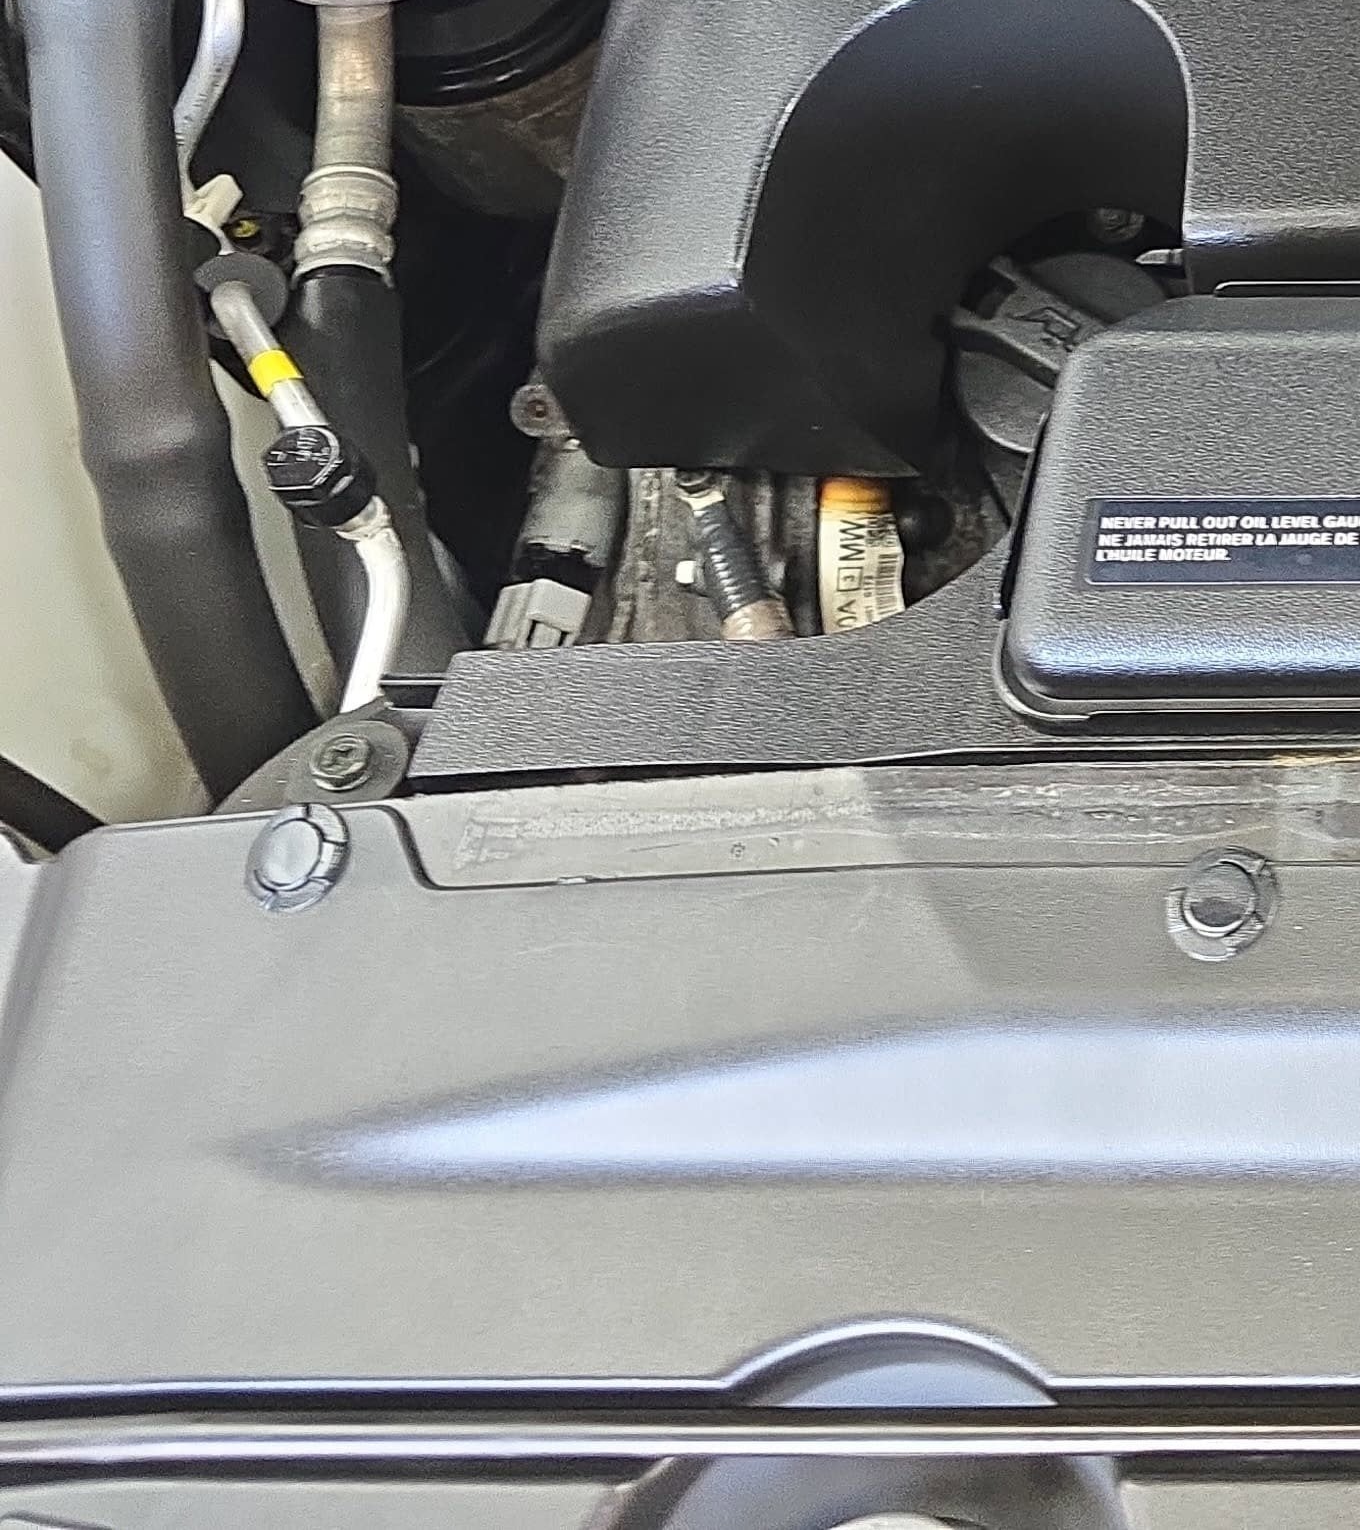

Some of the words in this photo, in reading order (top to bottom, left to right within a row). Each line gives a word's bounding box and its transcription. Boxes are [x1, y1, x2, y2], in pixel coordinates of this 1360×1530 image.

[1100, 516, 1156, 529] NEVER
[1157, 516, 1200, 529] PULL
[1202, 516, 1239, 529] OUT
[1240, 516, 1269, 529] OIL
[1271, 516, 1321, 528] LEVEL
[1098, 534, 1123, 547] NE
[1124, 534, 1184, 547] JAMAIS
[1185, 533, 1254, 546] RETIRER
[1255, 533, 1278, 546] LA
[1278, 532, 1333, 546] JAUGE
[1333, 532, 1359, 545] DE
